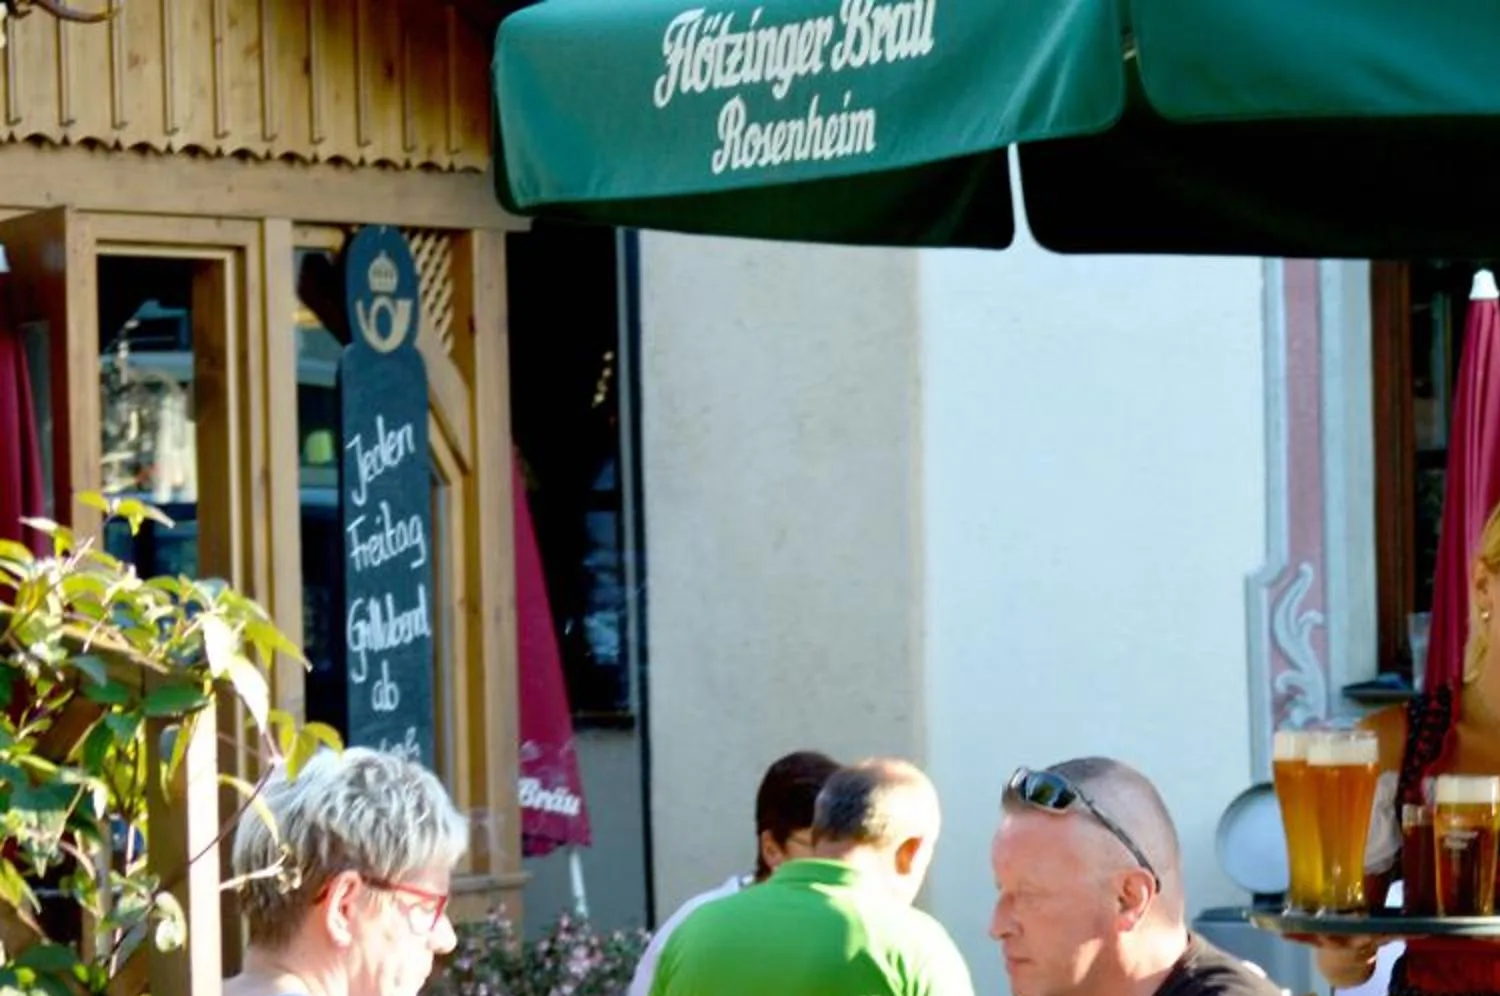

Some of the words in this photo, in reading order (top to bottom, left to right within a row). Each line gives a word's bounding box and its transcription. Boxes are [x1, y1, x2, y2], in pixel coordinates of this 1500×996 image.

[653, 7, 834, 108] Flötzinger
[711, 90, 877, 174] Rosenheim
[345, 414, 416, 507] Jeden
[346, 500, 427, 572] Freitag
[371, 659, 400, 711] ab
